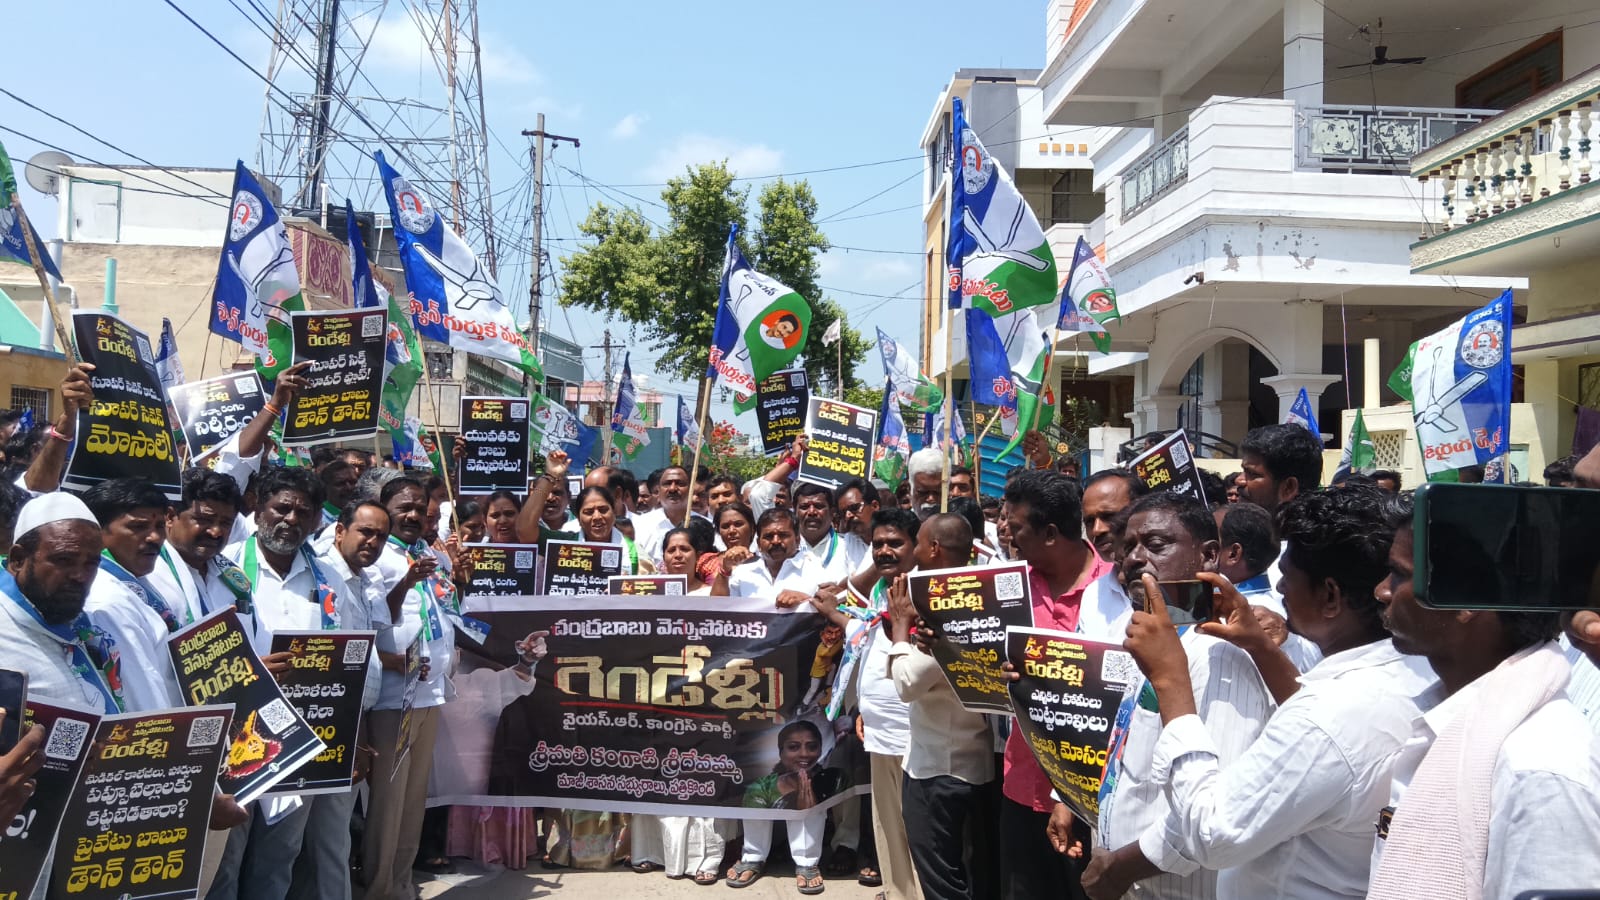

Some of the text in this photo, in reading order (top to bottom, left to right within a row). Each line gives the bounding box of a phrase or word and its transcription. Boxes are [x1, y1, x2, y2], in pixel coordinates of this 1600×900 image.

[442, 313, 498, 341] గుర్తుకే
[341, 389, 370, 402] బాబు
[89, 400, 139, 422] సూపర్
[295, 406, 329, 428] డౌన్
[332, 401, 371, 422] డౌన్!
[465, 429, 521, 442] యువతకు
[478, 446, 507, 457] బాబు
[466, 459, 521, 474] వెన్నుపోటు!
[495, 578, 518, 587] రంగం
[930, 592, 984, 611] రెండేళ్లు
[178, 621, 227, 656] చంద్రబాబు
[552, 617, 768, 641] చంద్రబాబు వెన్నుపోటుకు
[971, 630, 1006, 644] మోసం
[182, 630, 243, 675] వెన్నుపోటుకు
[189, 656, 259, 706] రెండేళ్లు
[554, 645, 785, 725] రెండేళ్లు
[1024, 659, 1084, 687] రెండేళ్లు
[1031, 689, 1060, 705] ఎన్నికల
[307, 704, 334, 719] నెలా
[562, 711, 642, 731] వైయస్.ఆర్.
[646, 718, 698, 735] కాంగ్రెస్
[101, 738, 169, 759] రెండేళ్లు
[1060, 741, 1107, 767] మోసం
[529, 740, 744, 784] శ్రీమతి కంగాటి శ్రీదేవమ్మ
[85, 769, 125, 785] మెడికల్
[669, 780, 716, 800] పత్తికొండ
[86, 798, 189, 832] కట్టబెడతారా?
[74, 826, 188, 863] ప్రైవేటు బాబూ
[66, 849, 186, 893] డౌన్ డౌన్
